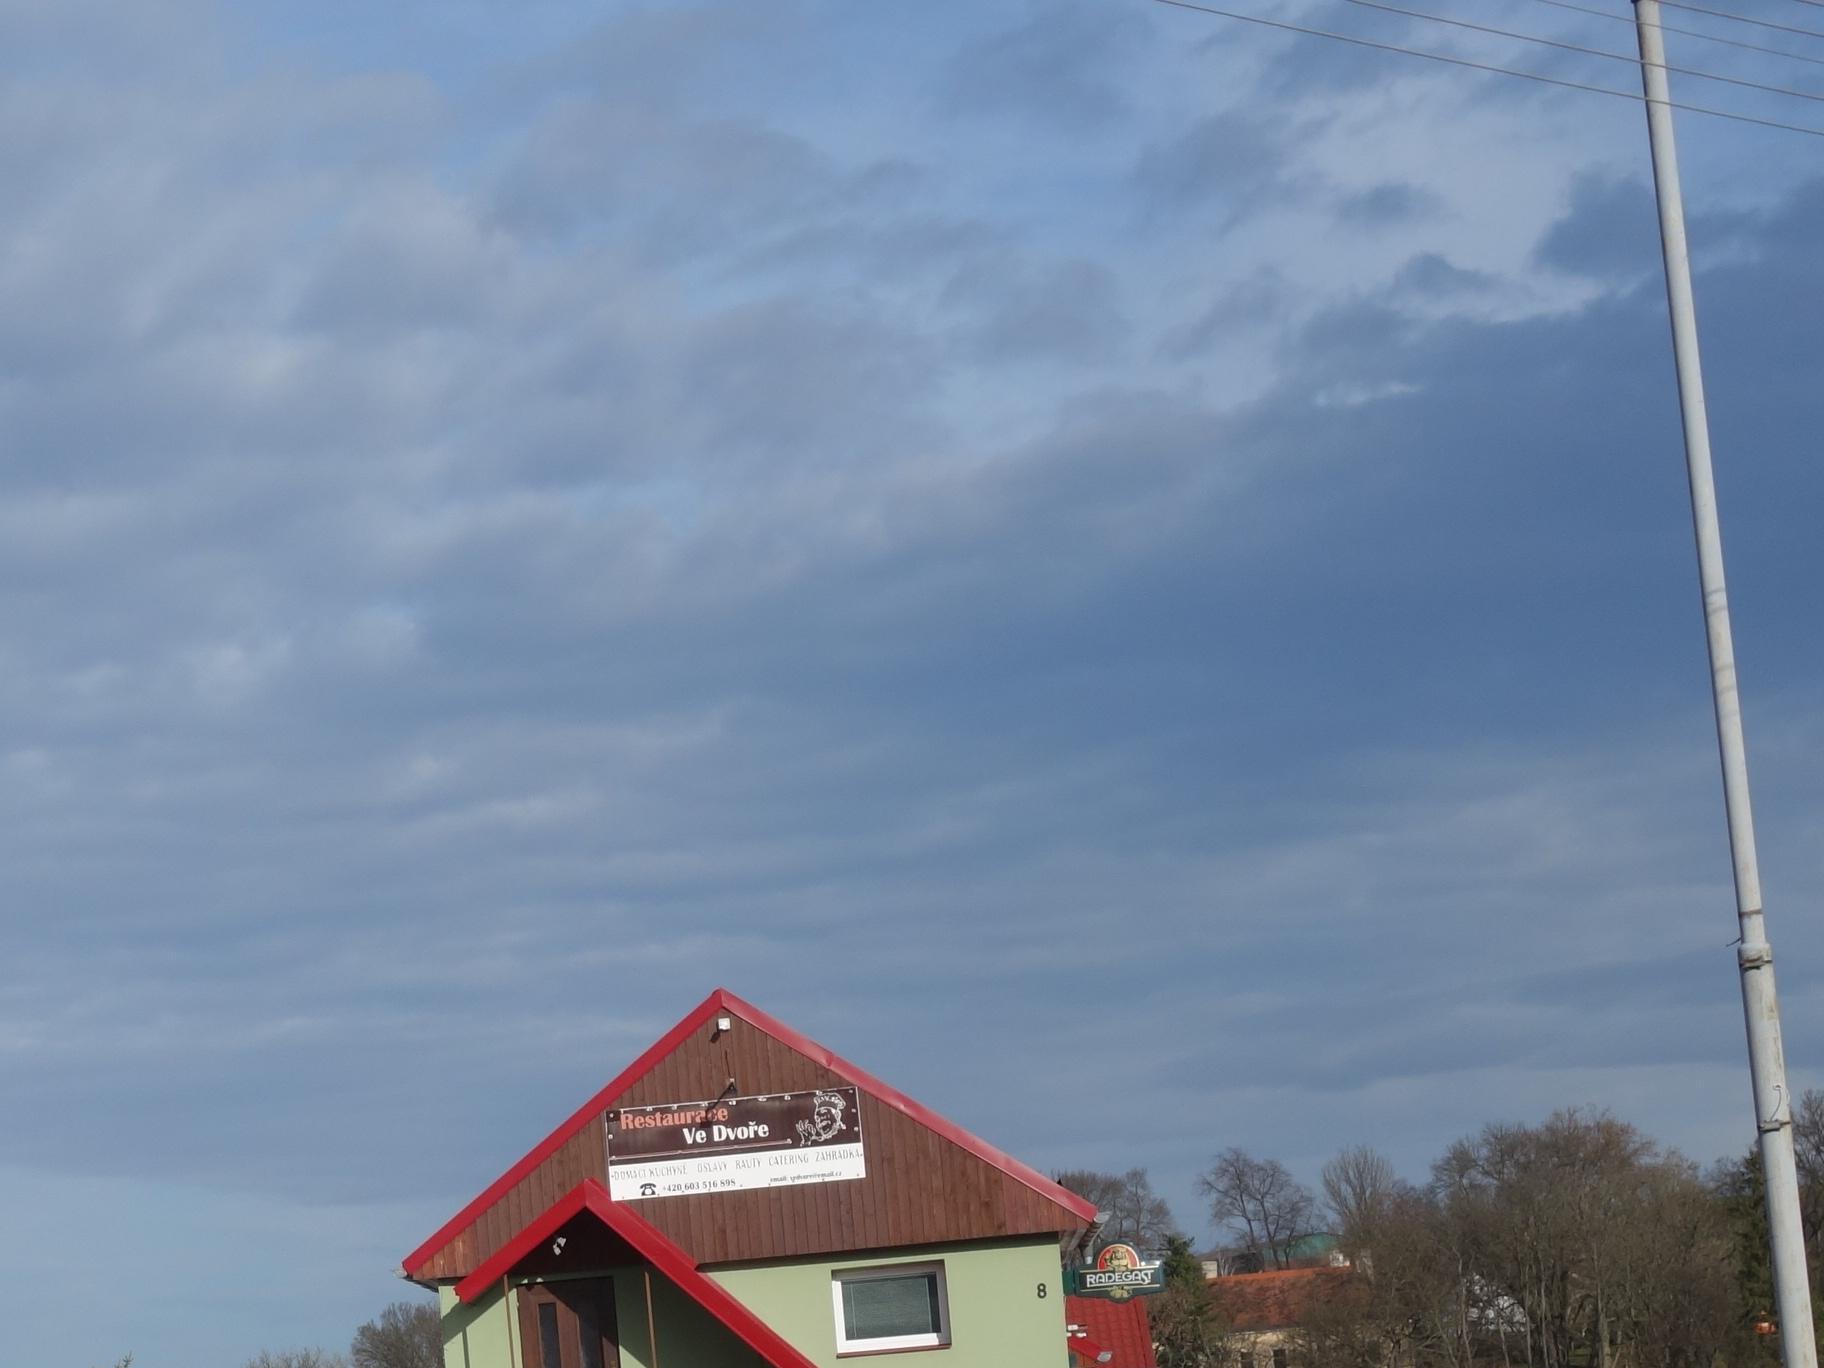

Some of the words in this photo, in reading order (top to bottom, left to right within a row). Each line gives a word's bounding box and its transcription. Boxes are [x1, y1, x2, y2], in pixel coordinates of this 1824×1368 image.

[621, 1108, 728, 1130] Restaurace
[682, 1127, 707, 1145] Ve
[713, 1121, 769, 1142] Dvoře
[768, 1153, 809, 1167] CATERING
[684, 1182, 700, 1192] 603
[702, 1180, 718, 1189] 516
[1087, 1270, 1155, 1288] RADEGAST
[1037, 1283, 1047, 1299] 8
